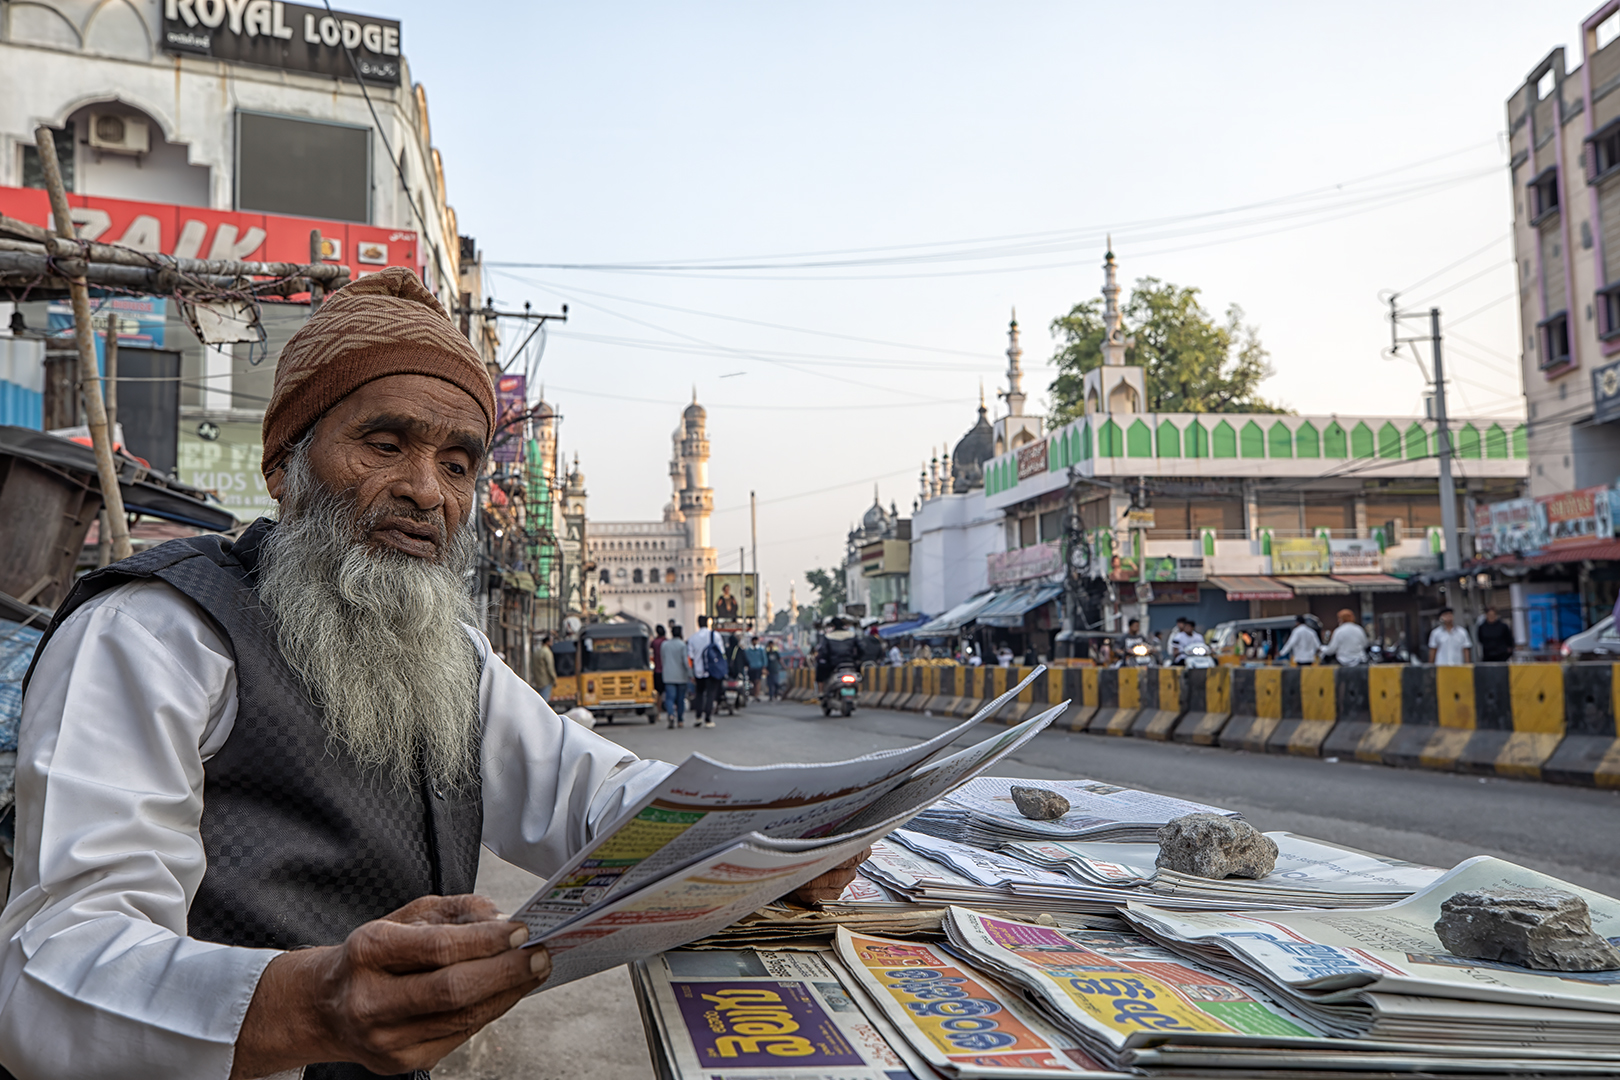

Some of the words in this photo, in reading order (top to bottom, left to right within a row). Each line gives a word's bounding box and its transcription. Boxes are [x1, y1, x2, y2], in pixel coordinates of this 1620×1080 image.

[165, 0, 294, 40] ROYAL
[304, 13, 400, 57] LODGE
[192, 472, 247, 492] KIDS
[701, 988, 816, 1058] వెలుగు
